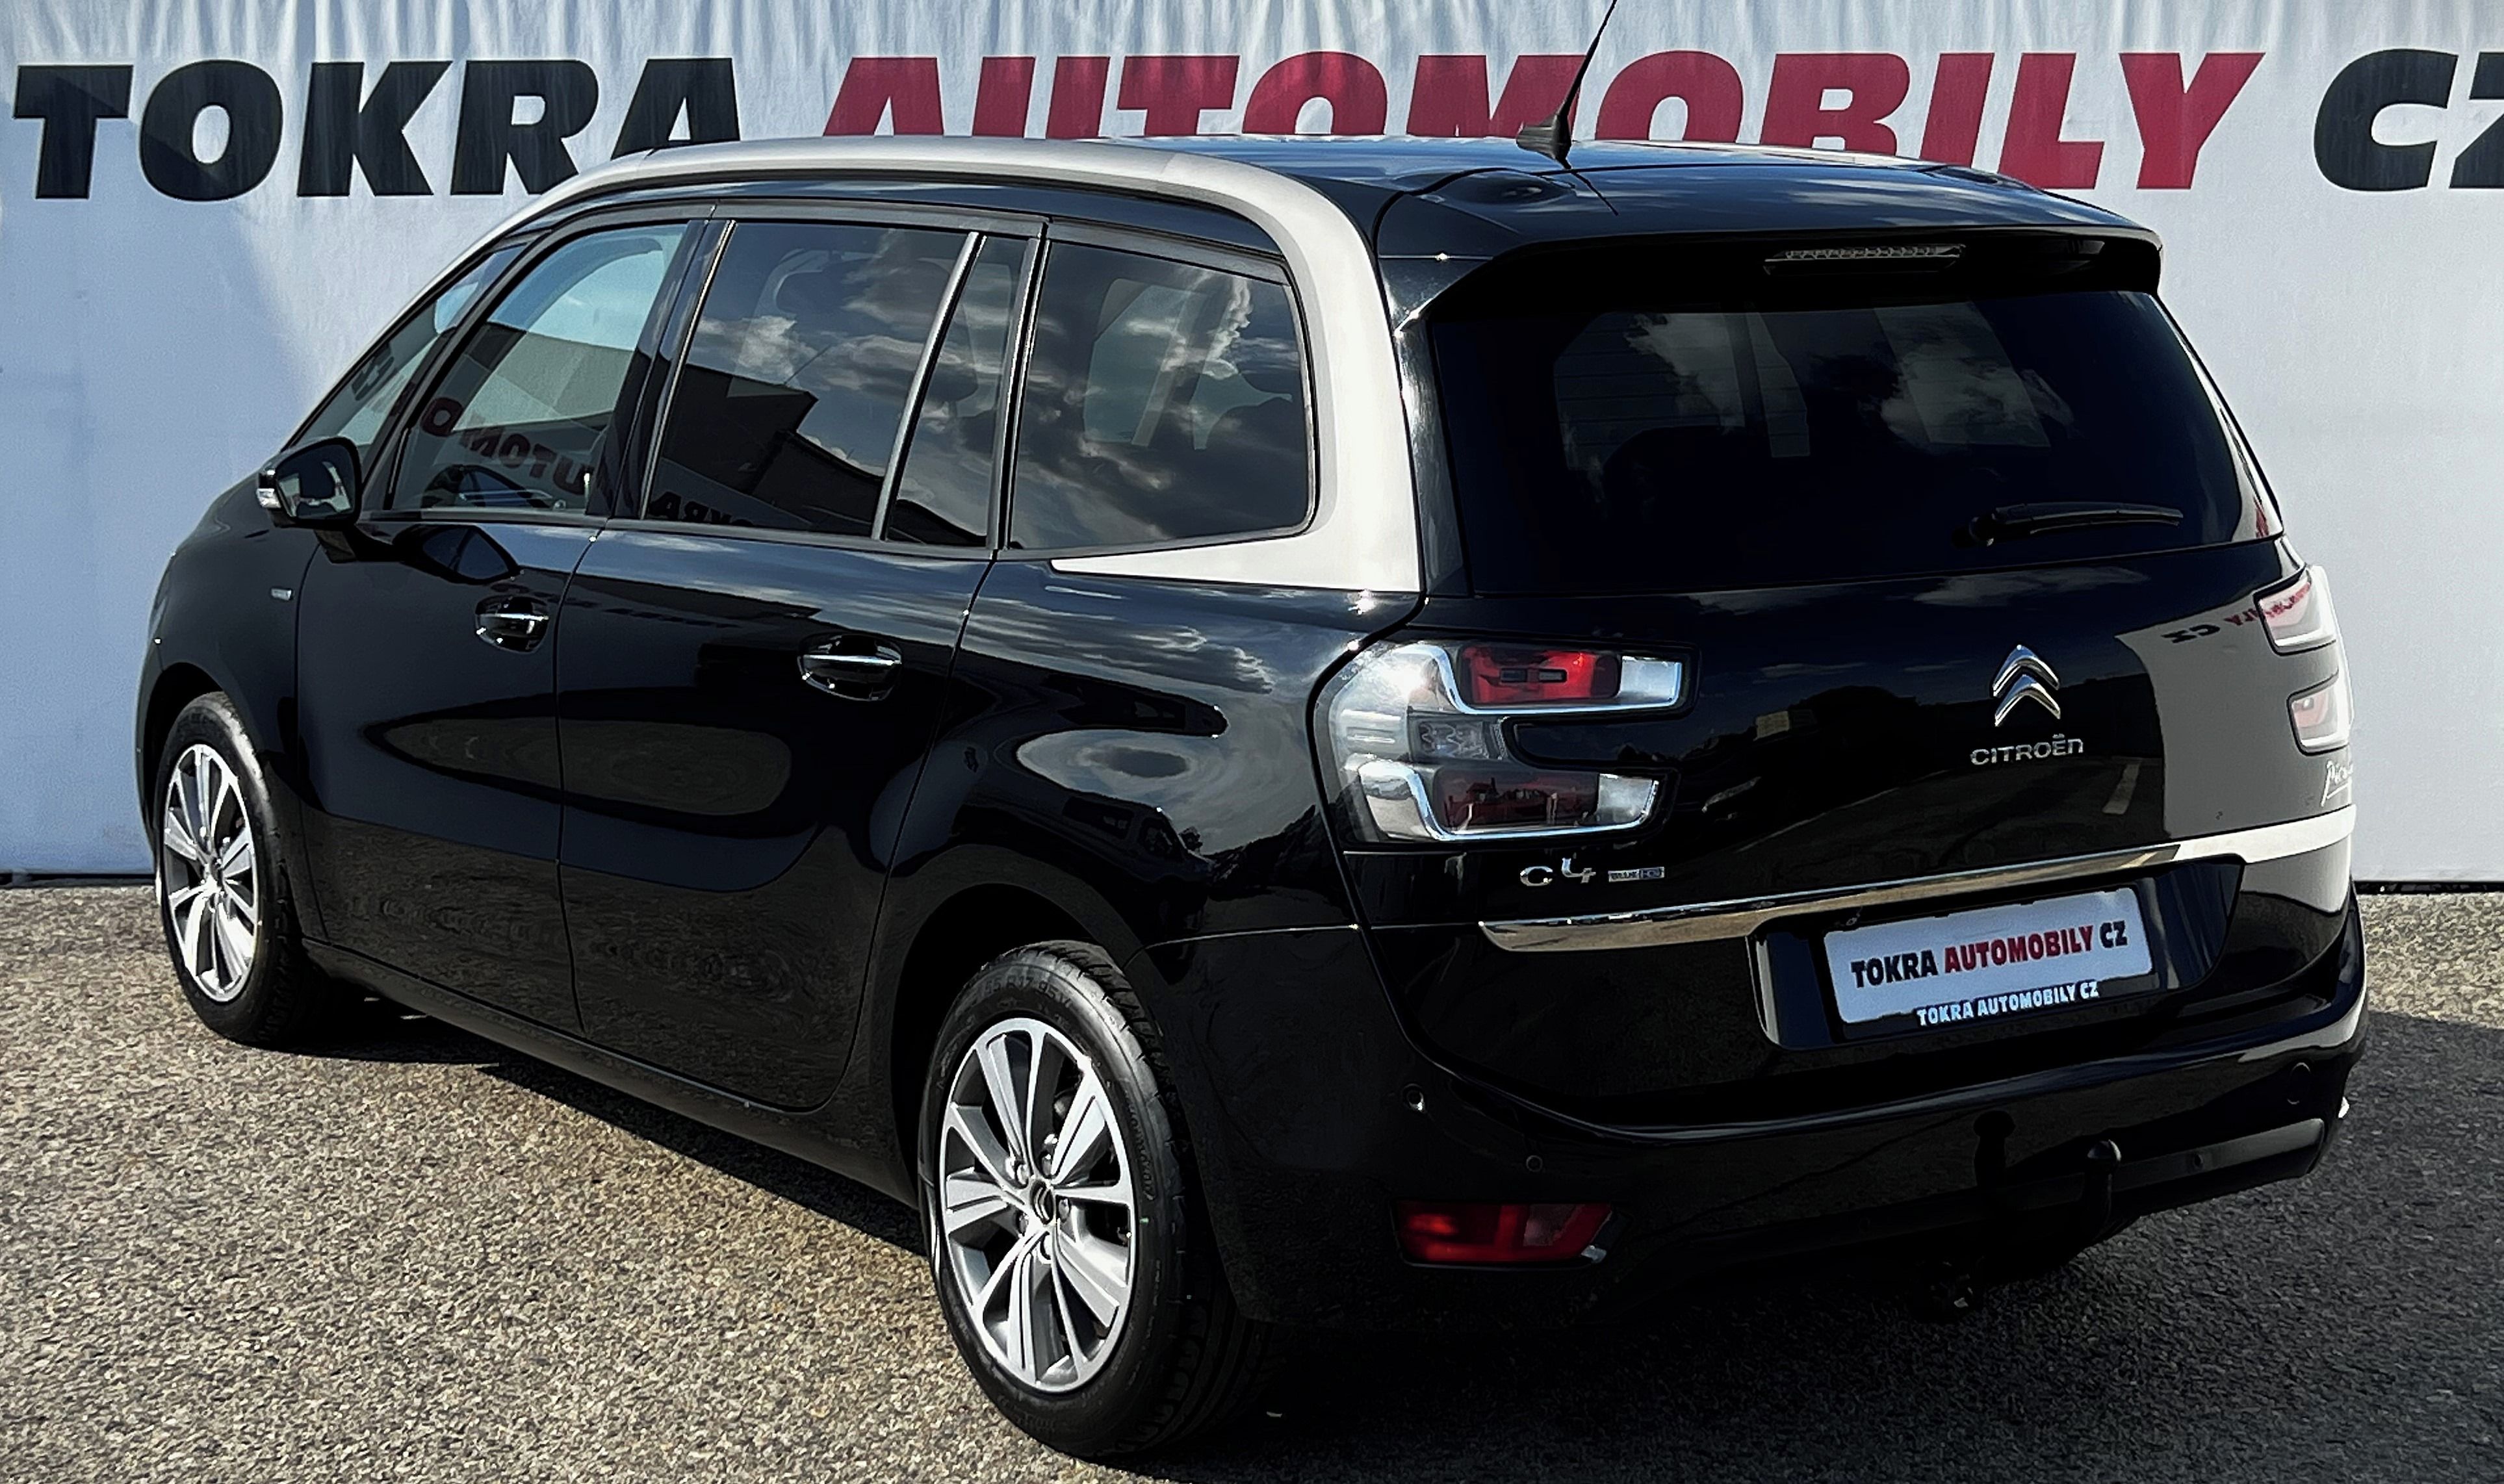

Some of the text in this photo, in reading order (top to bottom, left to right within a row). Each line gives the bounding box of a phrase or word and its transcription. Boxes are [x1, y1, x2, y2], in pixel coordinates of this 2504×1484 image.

[13, 57, 740, 201] TOKRA
[1520, 857, 1596, 886] C4
[1850, 920, 2128, 988] TOKRA AUTOMOBILY CZ
[1917, 981, 2098, 1026] TOKRA AUTOMOBILY CZ
